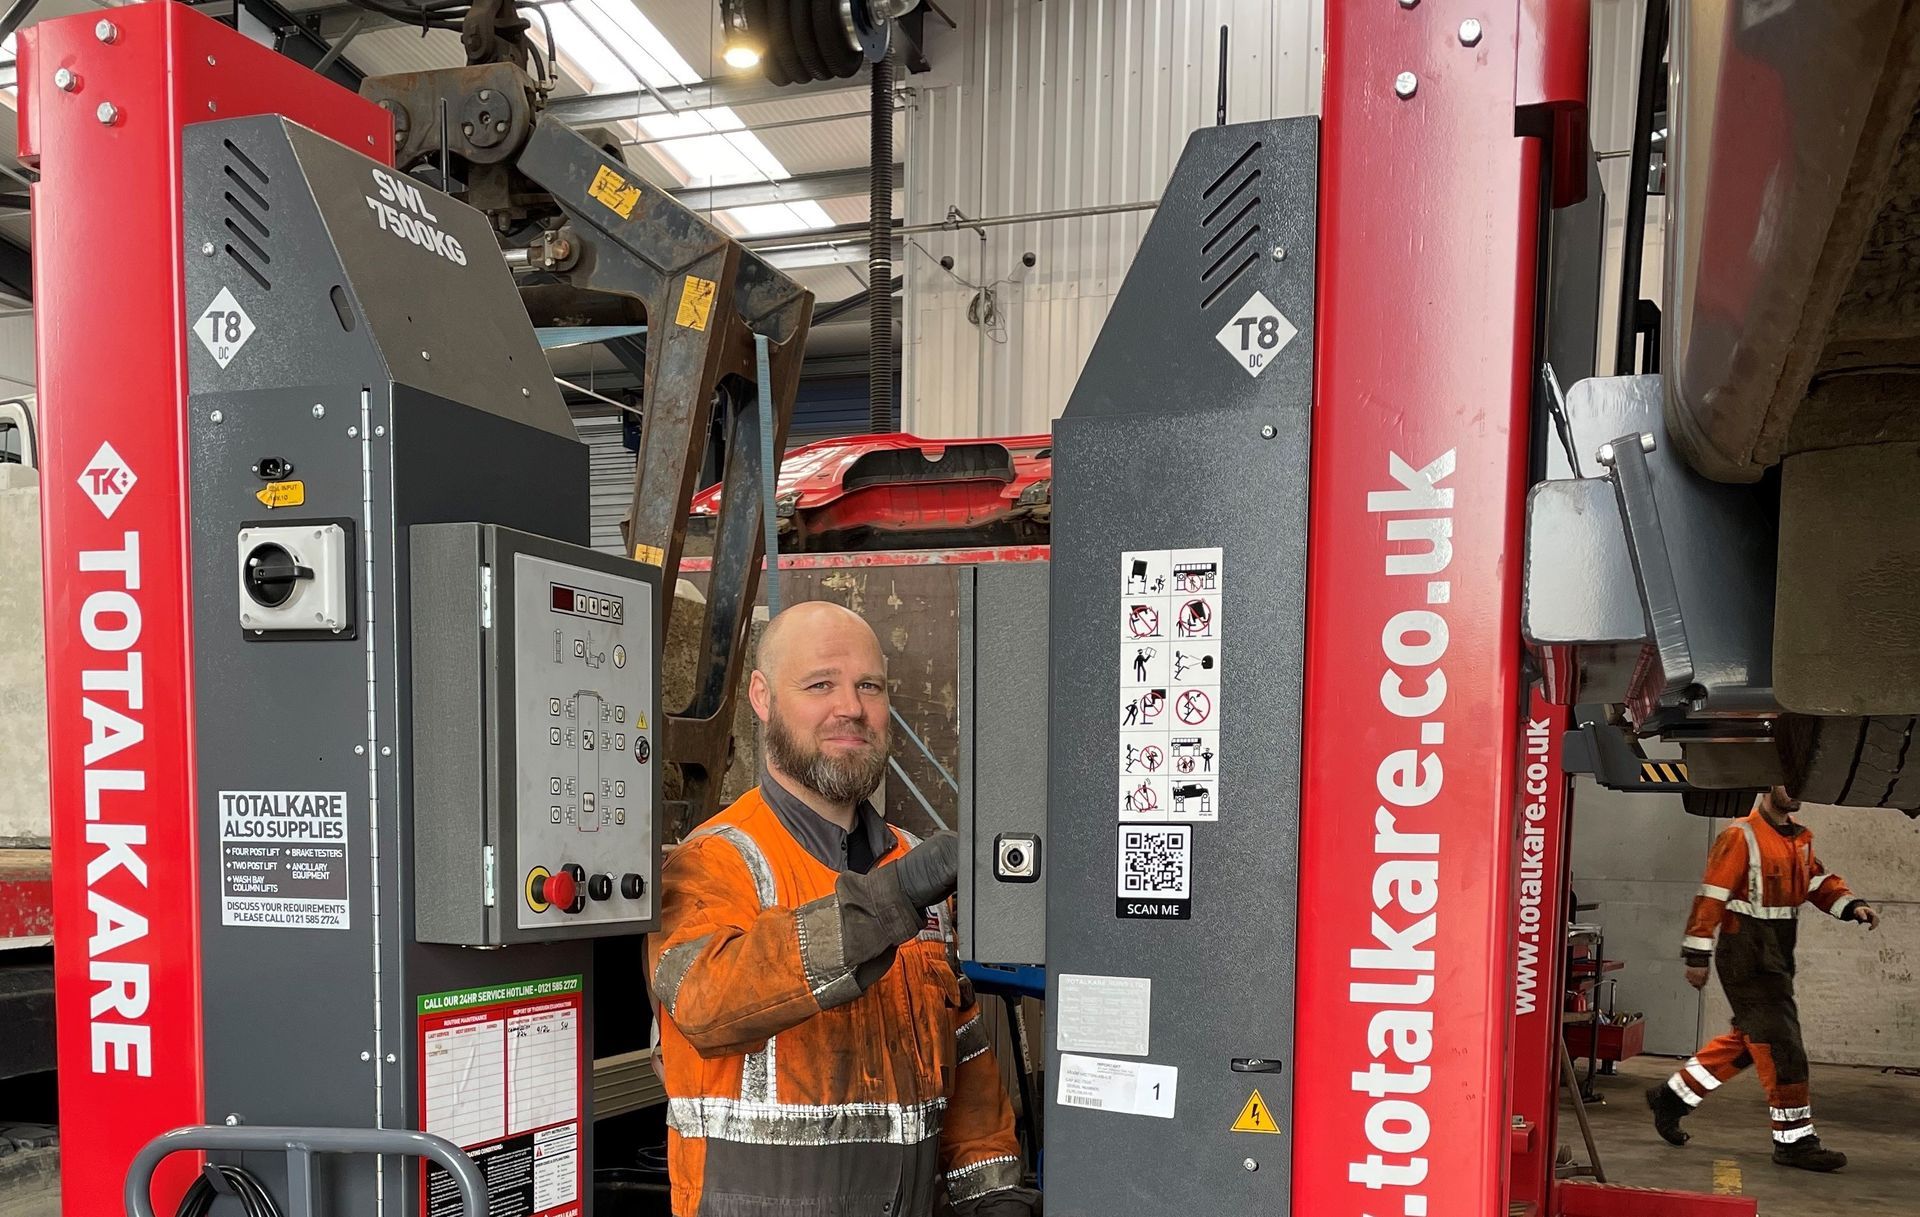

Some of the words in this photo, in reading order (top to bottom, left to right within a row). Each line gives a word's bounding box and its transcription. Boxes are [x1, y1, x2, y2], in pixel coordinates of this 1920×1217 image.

[372, 169, 437, 223] SWL
[366, 196, 467, 266] 7500KG
[206, 311, 241, 343] T8
[1232, 315, 1279, 350] T8
[219, 347, 229, 359] DC
[1249, 354, 1263, 368] DC
[79, 531, 152, 1078] TOTALKARE
[222, 794, 343, 817] TOTALKARE
[224, 820, 265, 837] ALSO
[267, 820, 343, 839] SUPPLIES
[1349, 448, 1458, 1217] .totalkare.co.uk
[232, 847, 249, 856] FOUR
[250, 847, 266, 856] POST
[266, 848, 280, 856] LIFT
[291, 848, 314, 857] BRAKE
[314, 849, 343, 857] TESTERS
[232, 861, 247, 870] TWO
[247, 861, 264, 870] POST
[264, 862, 278, 870] LIFT
[291, 862, 328, 871] ANCILLARY
[1515, 717, 1550, 1015] www.totalkare.co.uk
[232, 875, 252, 883] WASH
[252, 876, 265, 884] BAY
[292, 871, 330, 880] EQUIPMENT
[232, 883, 260, 891] COLUMN
[261, 884, 279, 893] LIFTS
[227, 901, 260, 911] DISCUSS
[260, 902, 282, 912] YOUR
[283, 903, 346, 914] REQUIREMENTS
[1127, 903, 1158, 915] SCAN
[1161, 905, 1180, 916] ME
[234, 912, 264, 921] PLEASE
[264, 913, 285, 923] CALL
[286, 914, 304, 923] 0121
[305, 915, 320, 924] 585
[320, 915, 340, 925] 2724
[424, 997, 443, 1010] CALL
[443, 995, 459, 1007] OUR
[459, 993, 478, 1005] 24HR
[478, 988, 506, 1002] SERVICE
[506, 985, 534, 998] HOTLINE
[537, 982, 552, 994] 0121
[563, 978, 578, 990] 2727
[1153, 1083, 1160, 1100] 1
